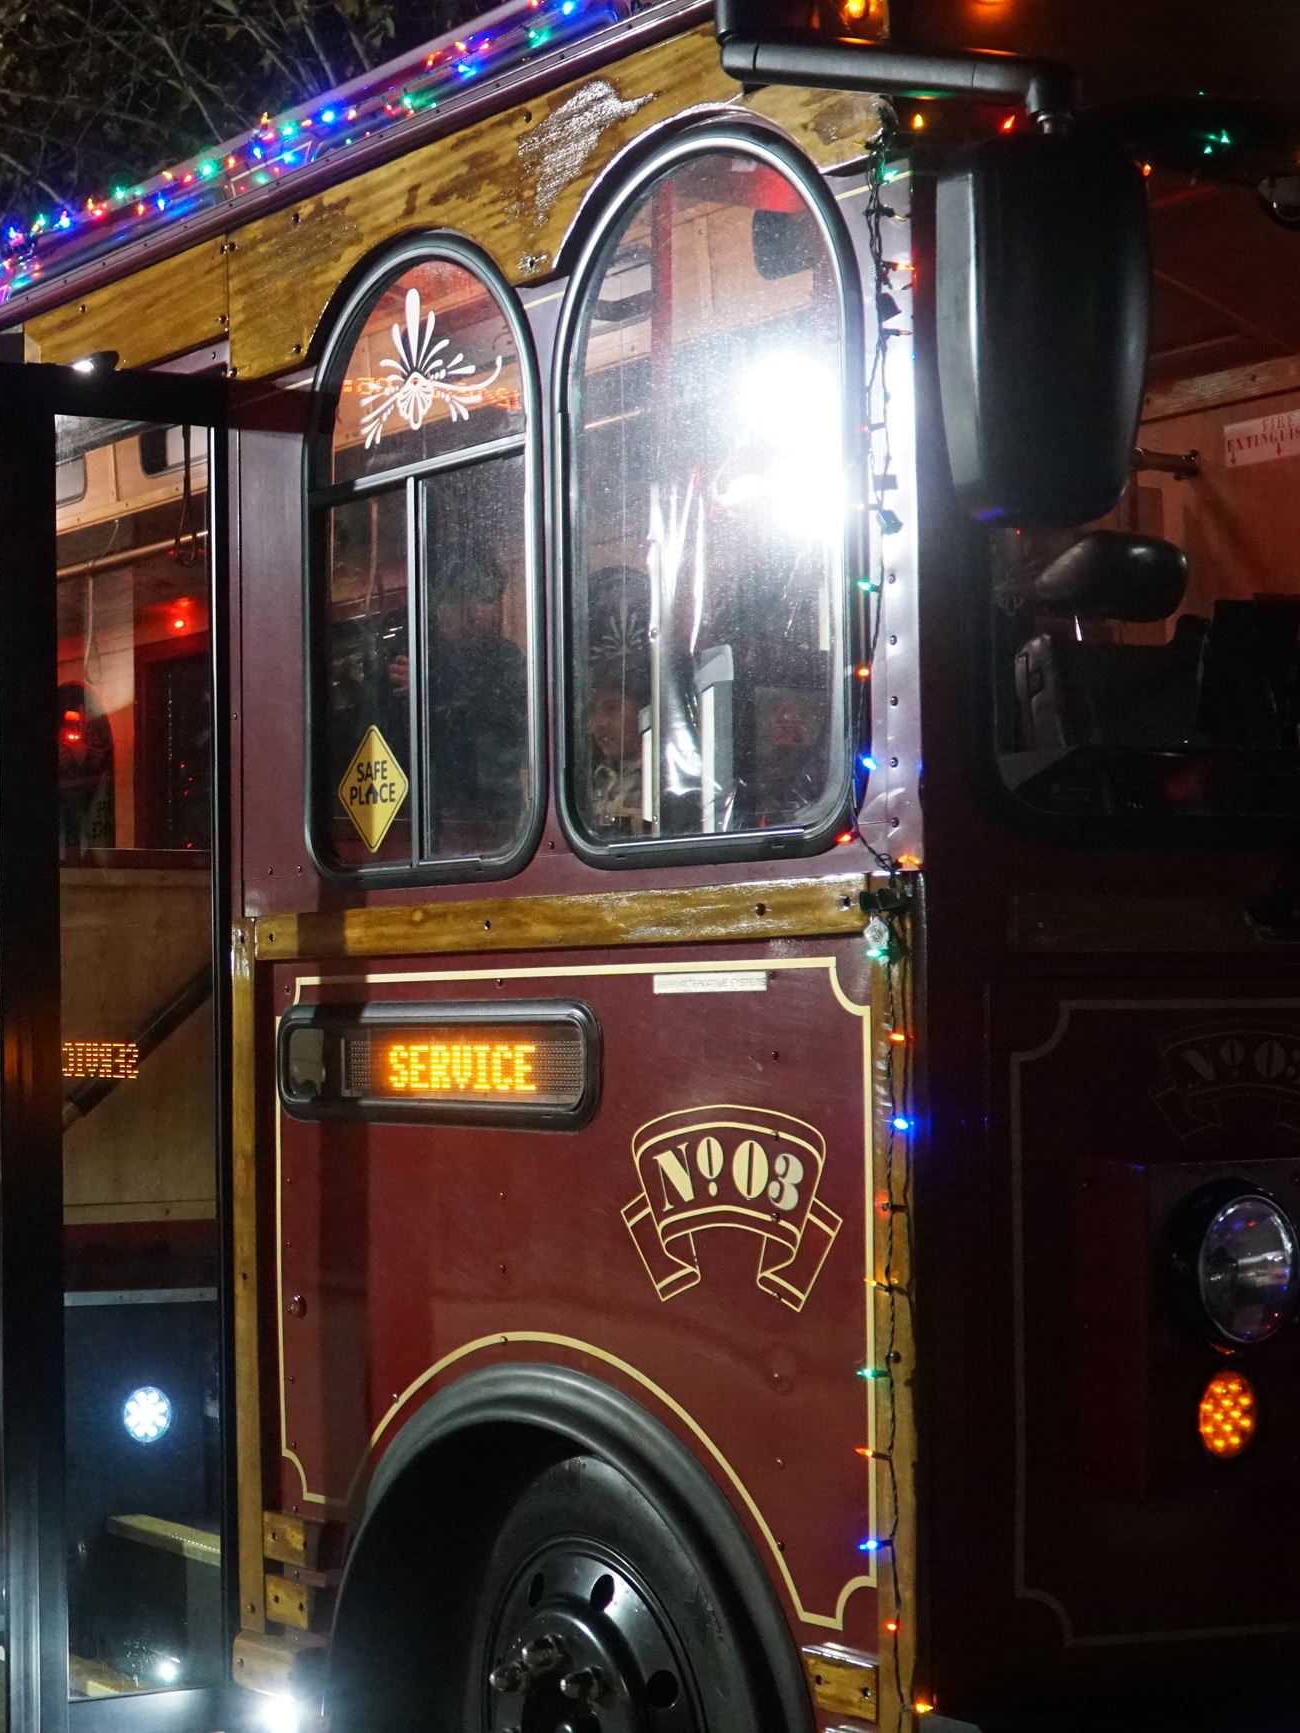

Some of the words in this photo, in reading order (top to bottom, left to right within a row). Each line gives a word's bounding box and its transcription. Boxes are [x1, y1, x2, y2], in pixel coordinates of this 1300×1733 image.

[356, 760, 388, 782] SAFE
[349, 783, 396, 805] PLACE
[388, 1044, 537, 1092] SERVICE
